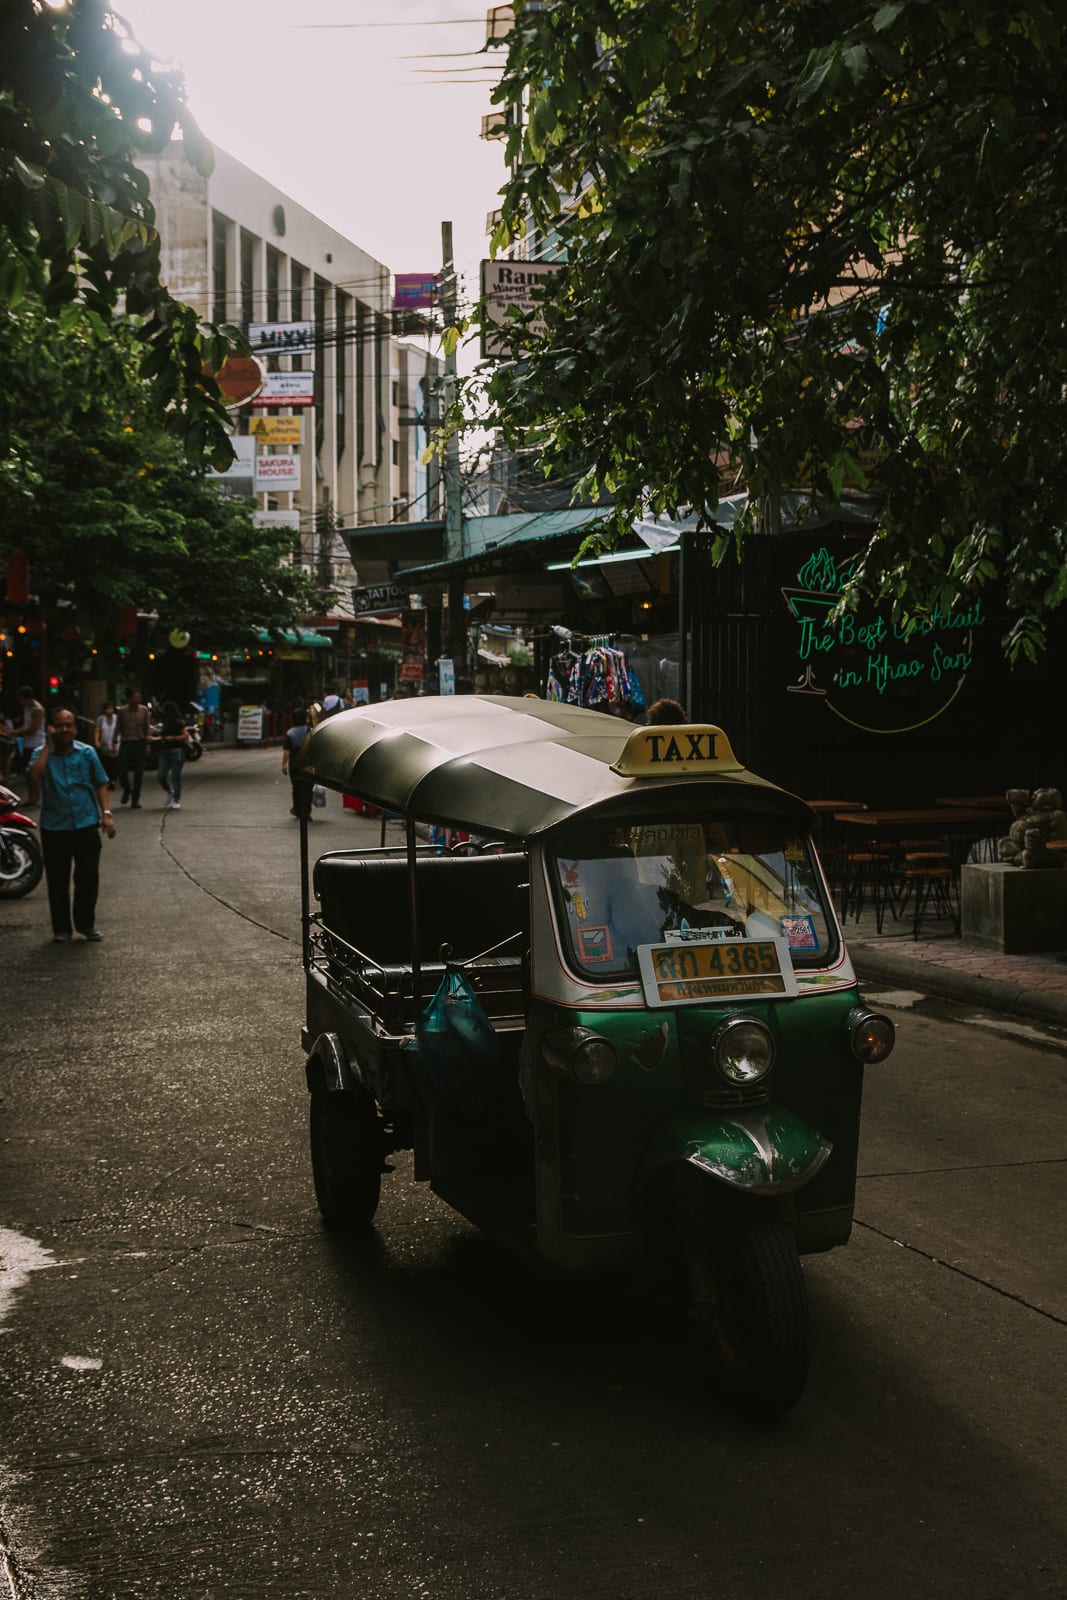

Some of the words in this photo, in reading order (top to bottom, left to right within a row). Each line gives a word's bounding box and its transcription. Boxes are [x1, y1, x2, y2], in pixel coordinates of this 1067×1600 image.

[258, 459, 294, 467] SAKURA
[258, 468, 294, 476] HOUSE
[367, 585, 407, 599] TATTOO
[797, 616, 835, 660] The
[839, 613, 888, 650] Best
[838, 666, 863, 689] in
[867, 653, 925, 693] Khao
[930, 643, 972, 681] San
[645, 733, 718, 762] TAXI
[709, 945, 775, 975] 4365
